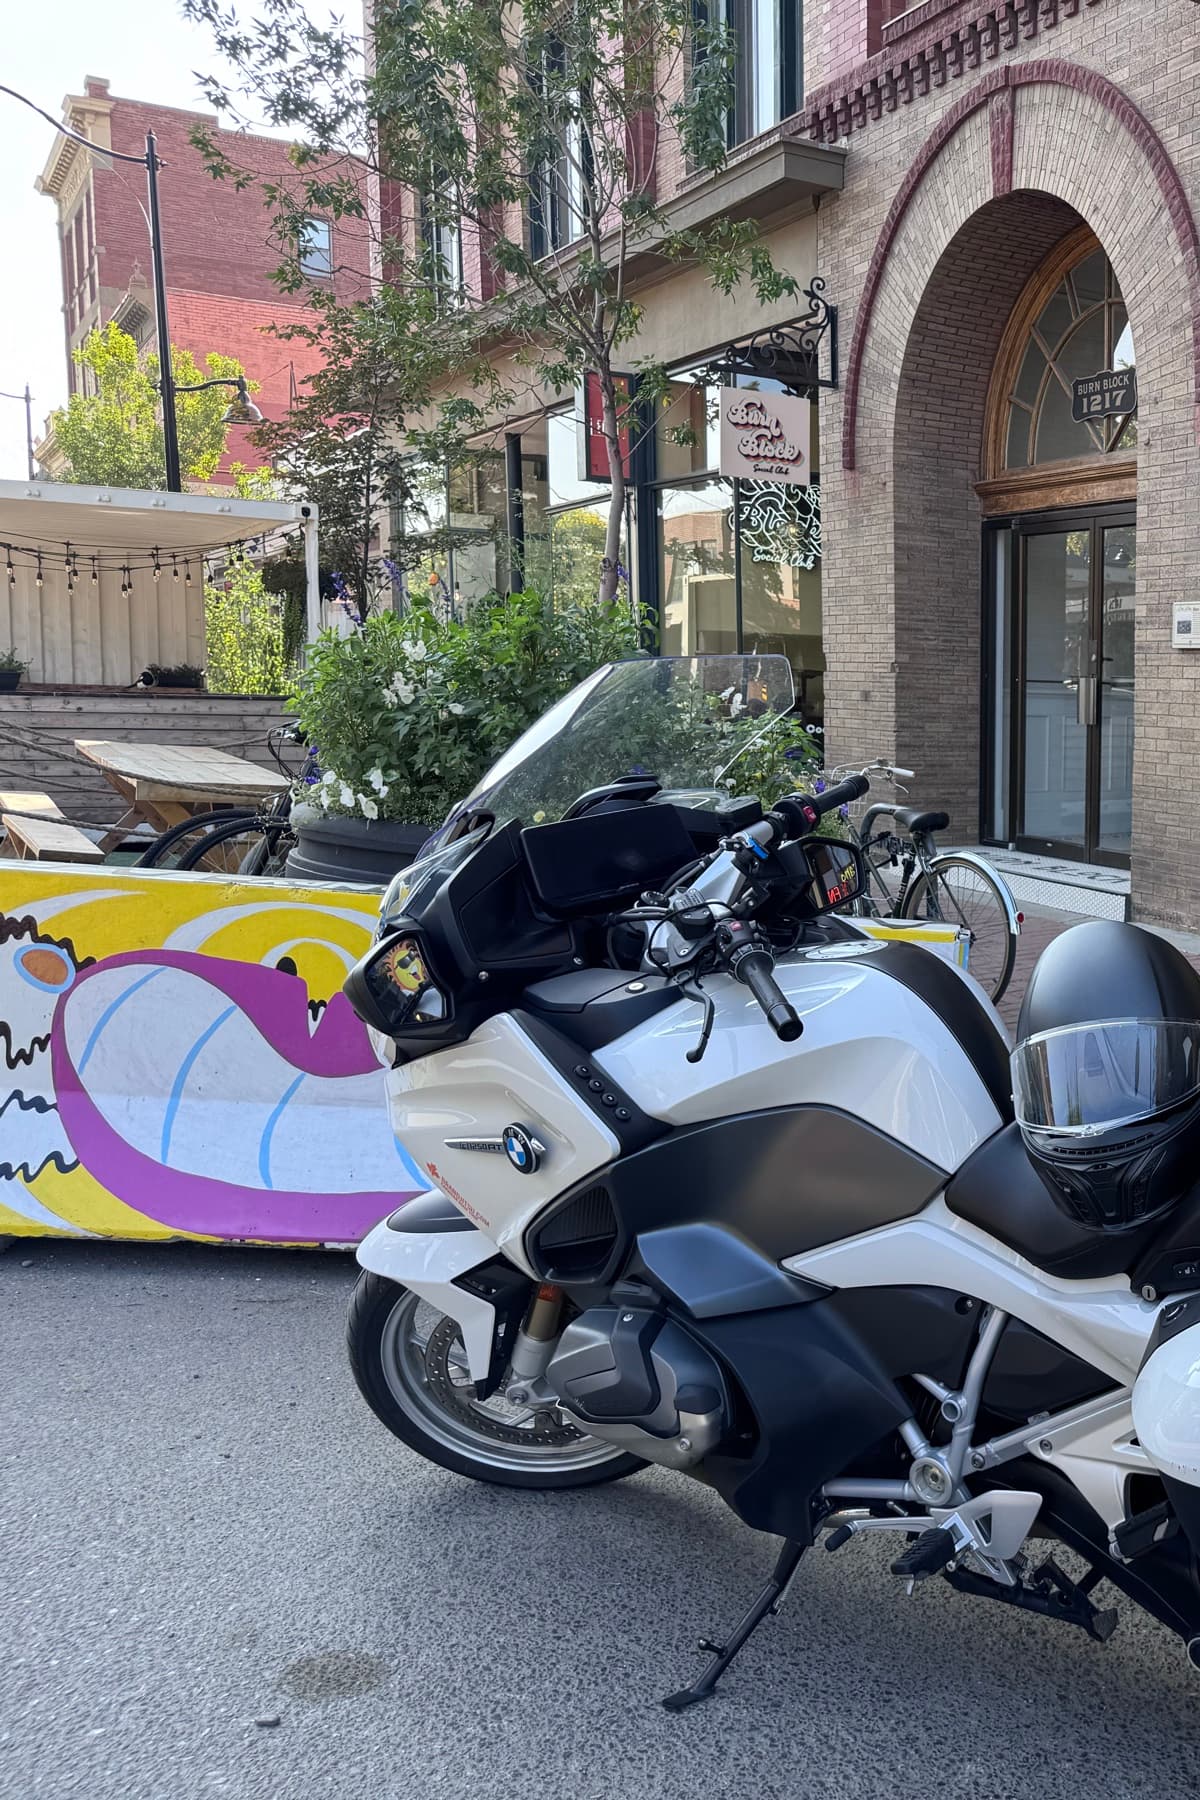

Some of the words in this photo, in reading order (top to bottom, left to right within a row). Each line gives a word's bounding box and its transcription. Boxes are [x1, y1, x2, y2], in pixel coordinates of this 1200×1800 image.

[1077, 380, 1100, 396] BURN
[1103, 374, 1130, 390] BLOCK
[1082, 389, 1127, 413] 1217
[727, 398, 784, 440] Burn
[738, 429, 804, 464] Block
[753, 463, 773, 475] Social
[774, 466, 791, 476] Club
[753, 546, 789, 565] Social
[789, 551, 816, 571] Club
